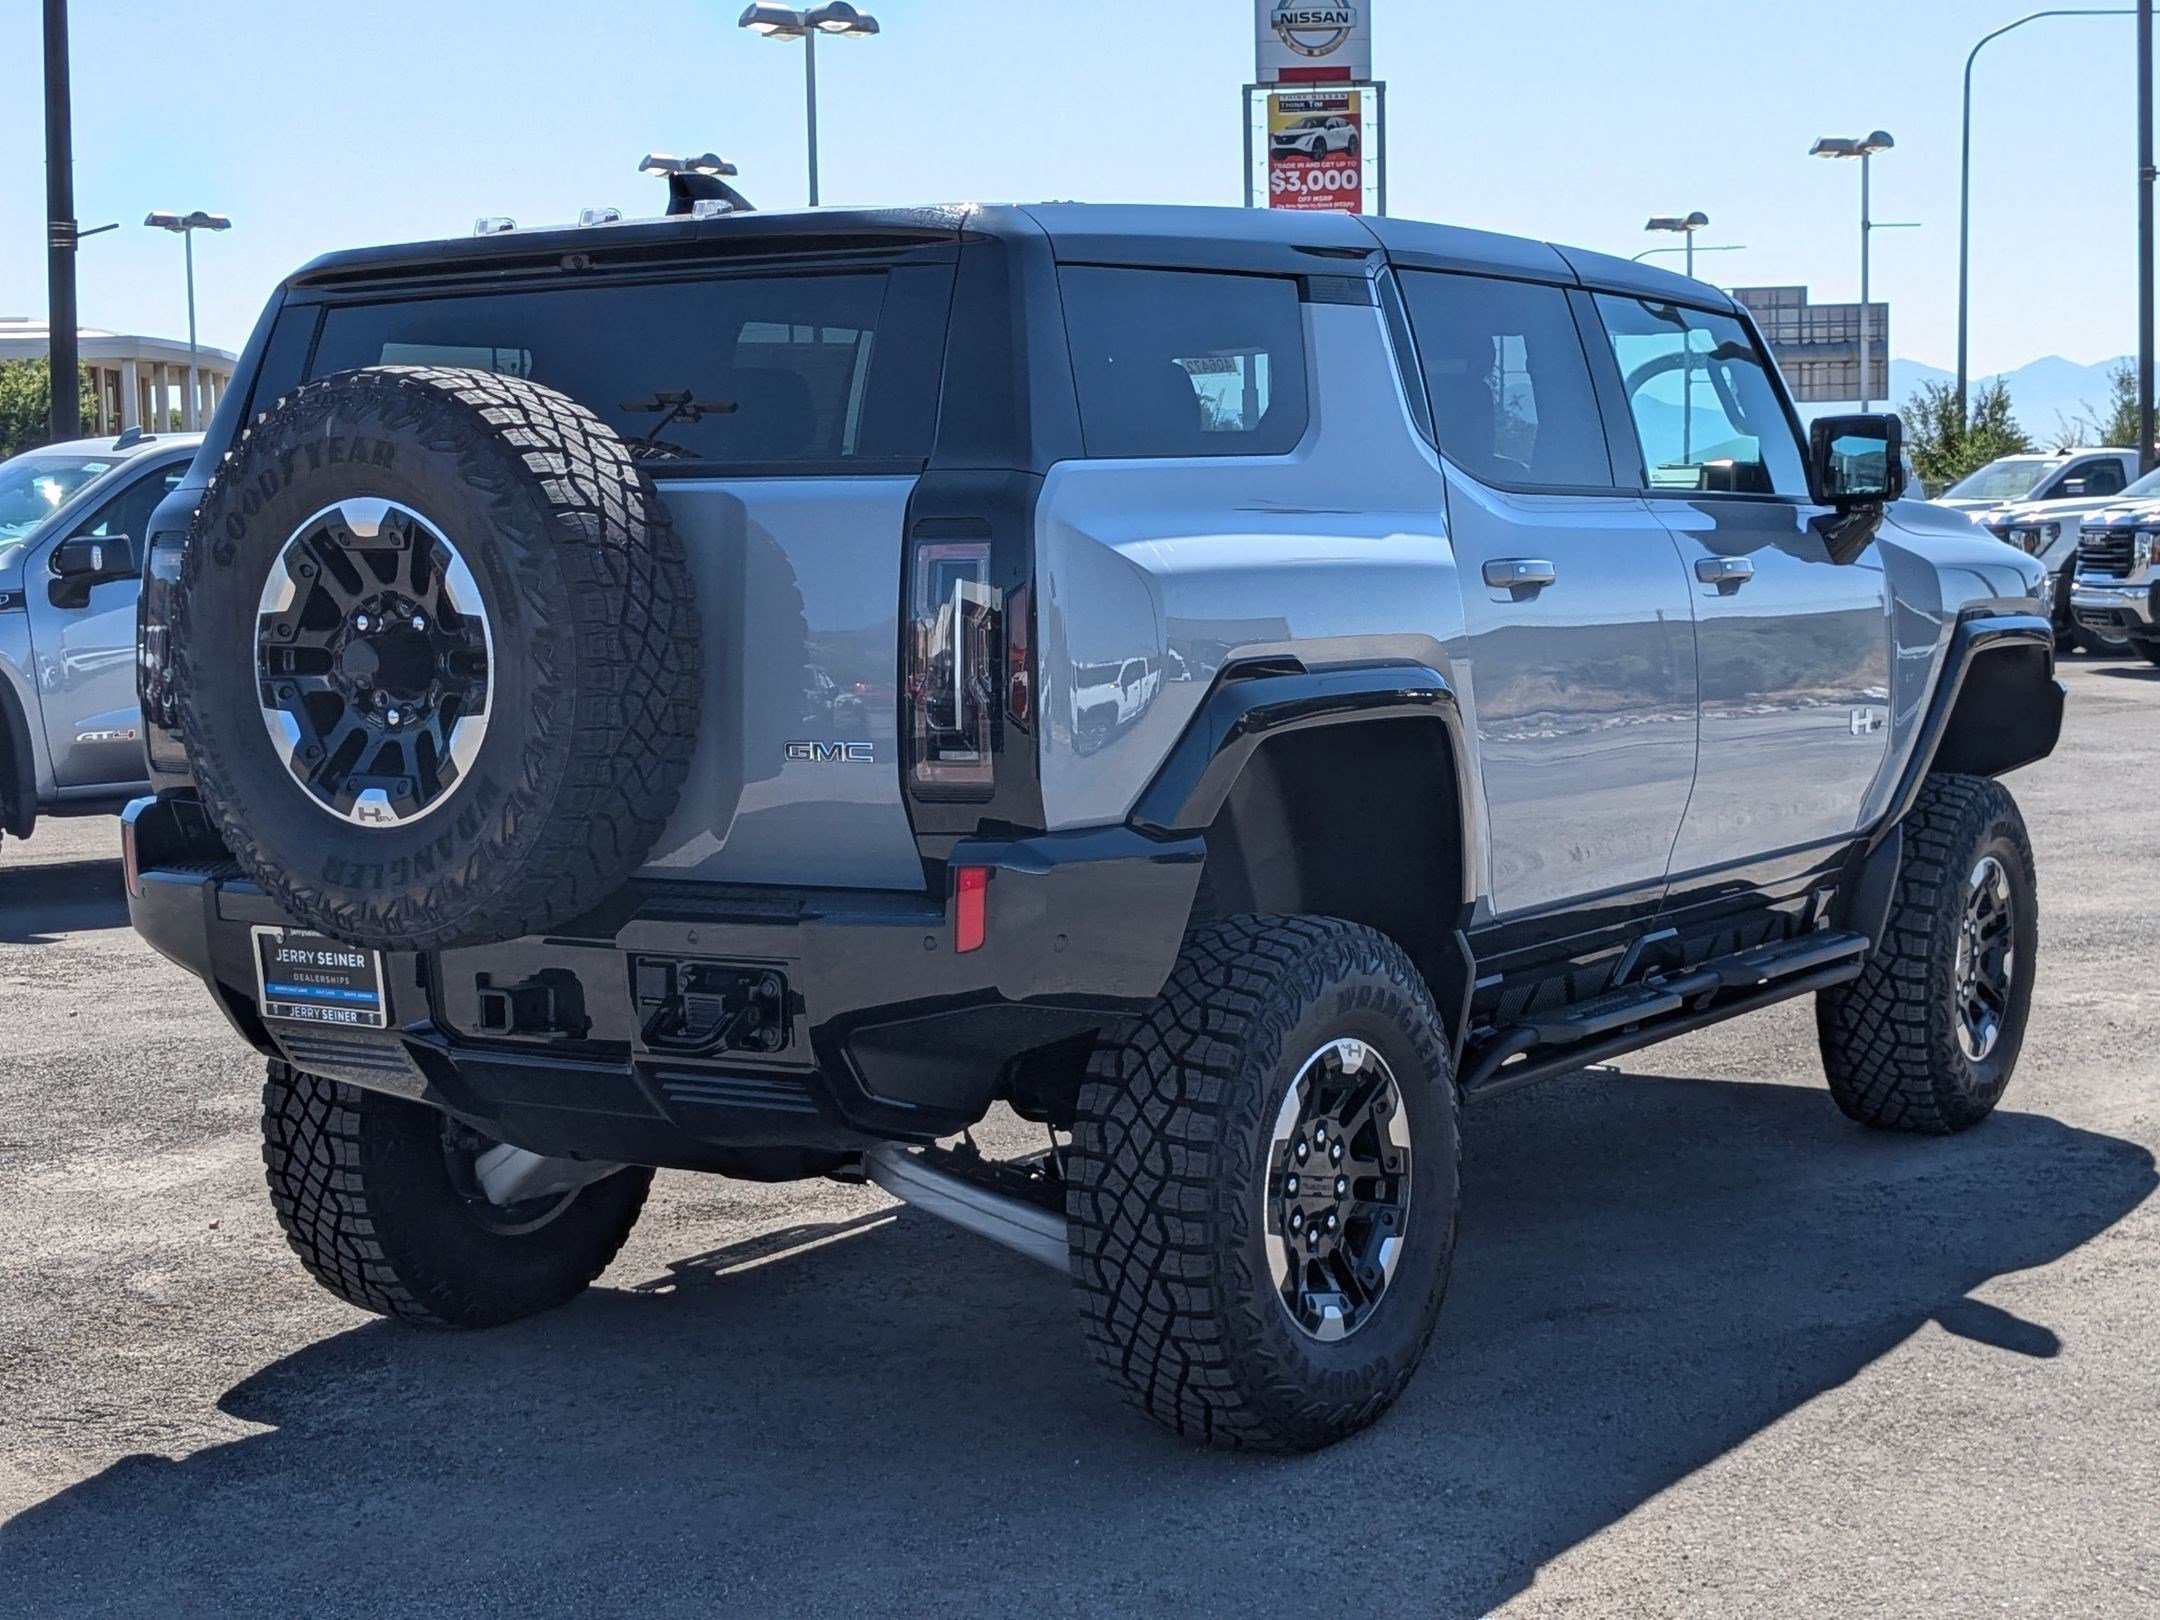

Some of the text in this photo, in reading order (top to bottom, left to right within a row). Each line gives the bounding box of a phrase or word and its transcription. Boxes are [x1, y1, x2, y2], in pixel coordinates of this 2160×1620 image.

[1280, 11, 1349, 24] NISSAN
[1271, 169, 1359, 195] $3,000
[213, 435, 396, 567] GOODYEAR
[76, 728, 136, 742] AT4
[783, 740, 875, 764] GMC
[276, 949, 365, 968] JERRY SEINER
[293, 973, 351, 986] DEALERSHIPS
[289, 1006, 358, 1022] JERRY SEINER
[1336, 984, 1441, 1082] WRANGLER
